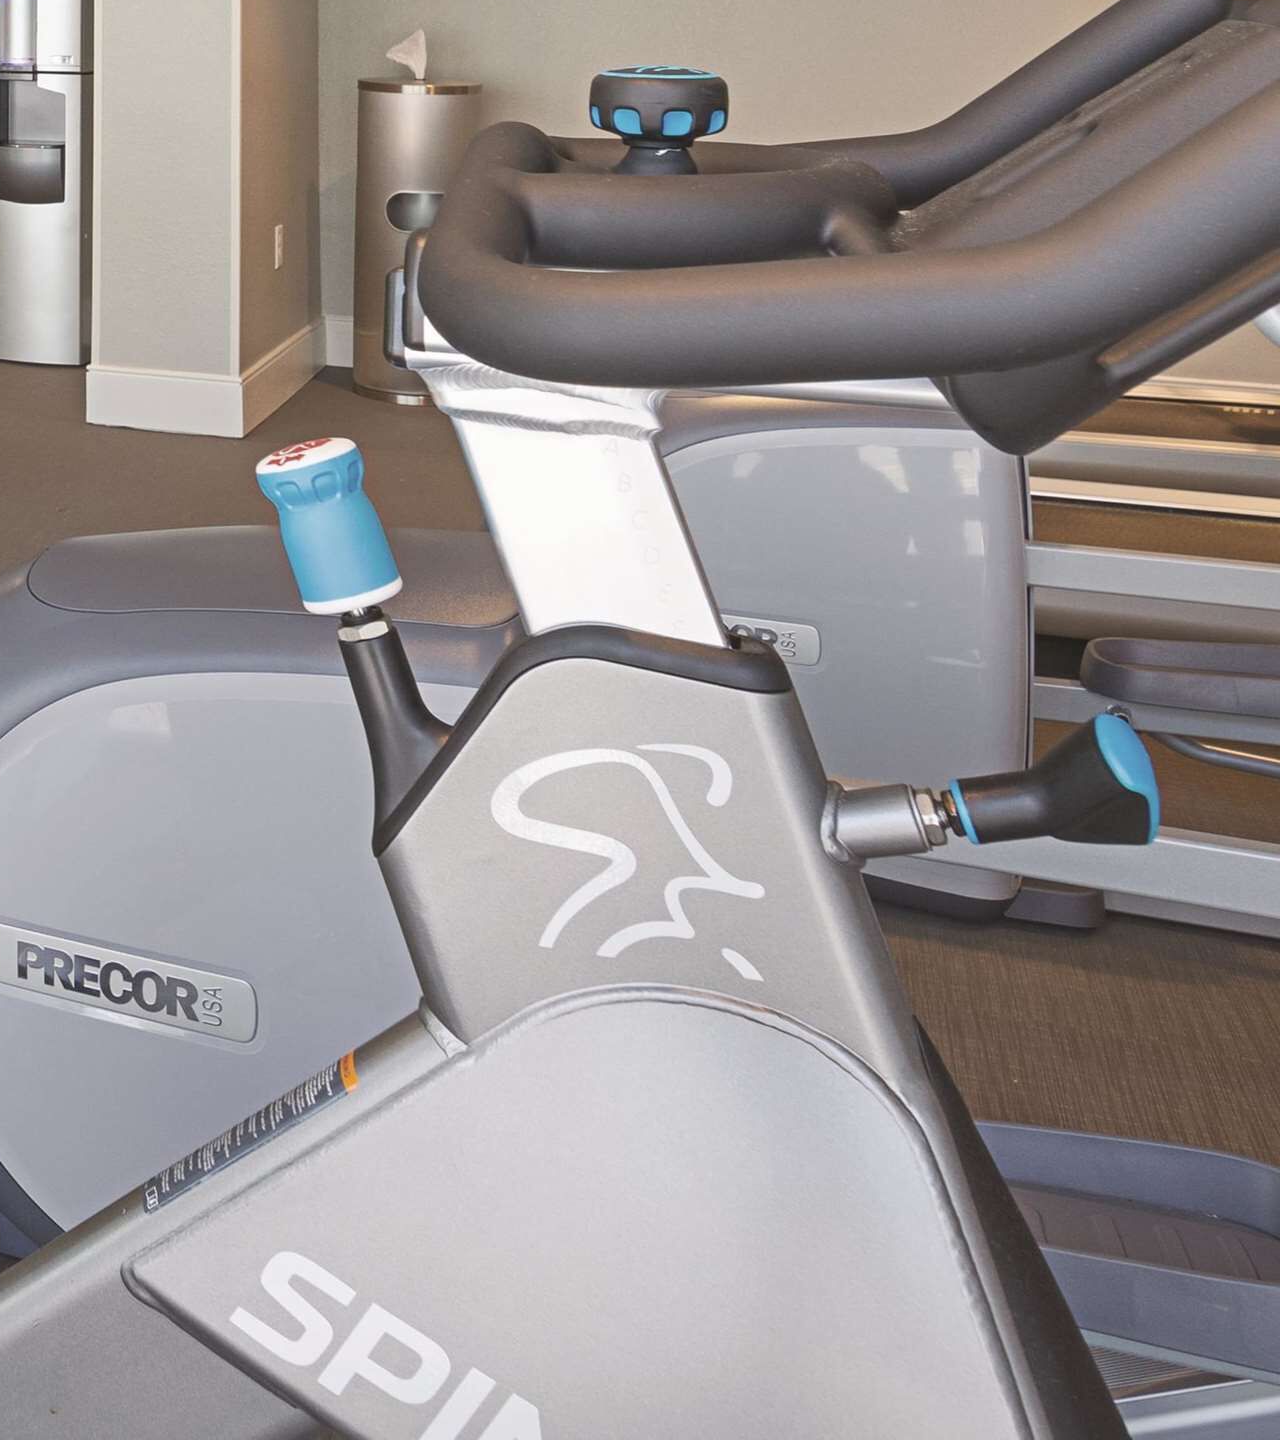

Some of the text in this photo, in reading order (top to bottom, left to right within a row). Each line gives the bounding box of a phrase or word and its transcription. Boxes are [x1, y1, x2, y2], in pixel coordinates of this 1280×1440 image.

[781, 630, 796, 658] USA
[17, 941, 200, 1022] PRECOR
[202, 987, 222, 1027] USA
